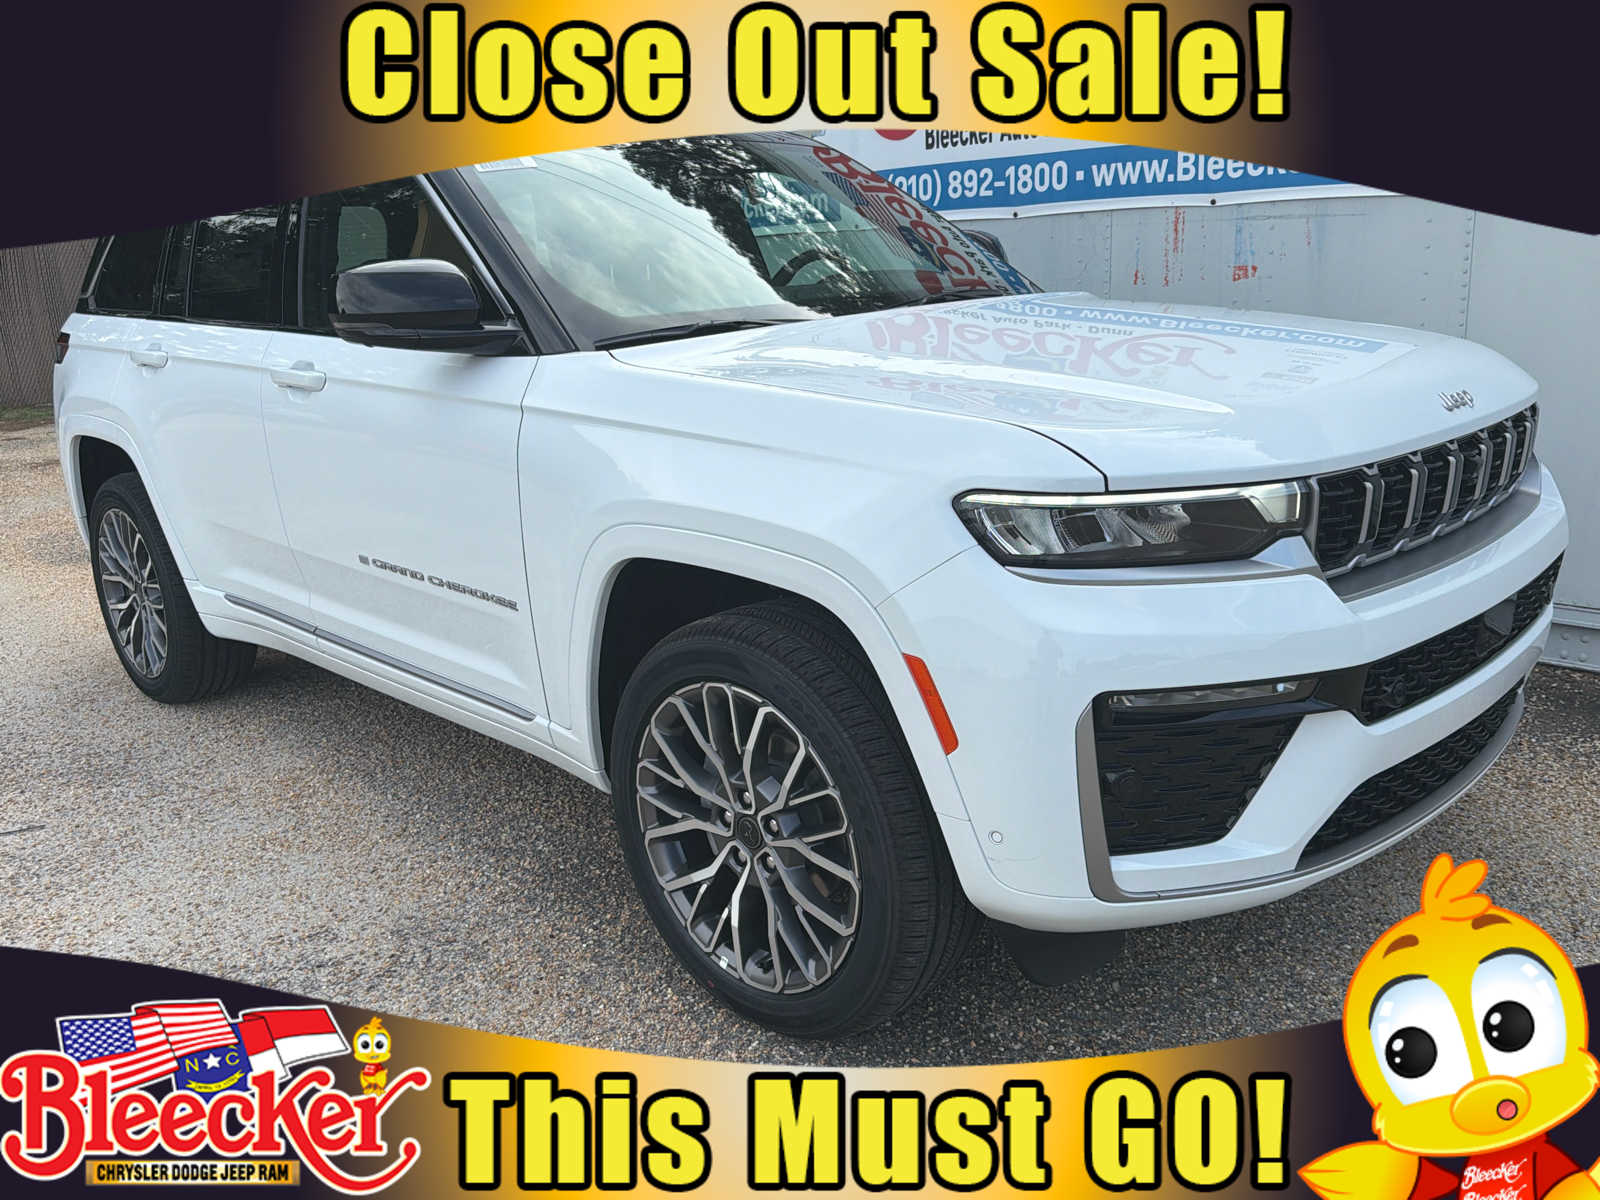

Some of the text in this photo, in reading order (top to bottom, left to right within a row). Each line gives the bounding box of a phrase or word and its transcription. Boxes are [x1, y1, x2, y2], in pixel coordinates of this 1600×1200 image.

[948, 160, 1068, 199] 892-1800
[1091, 152, 1301, 188] www.Bleec
[1439, 390, 1474, 411] Jeep
[371, 558, 519, 611] GRAND CHEROKEE
